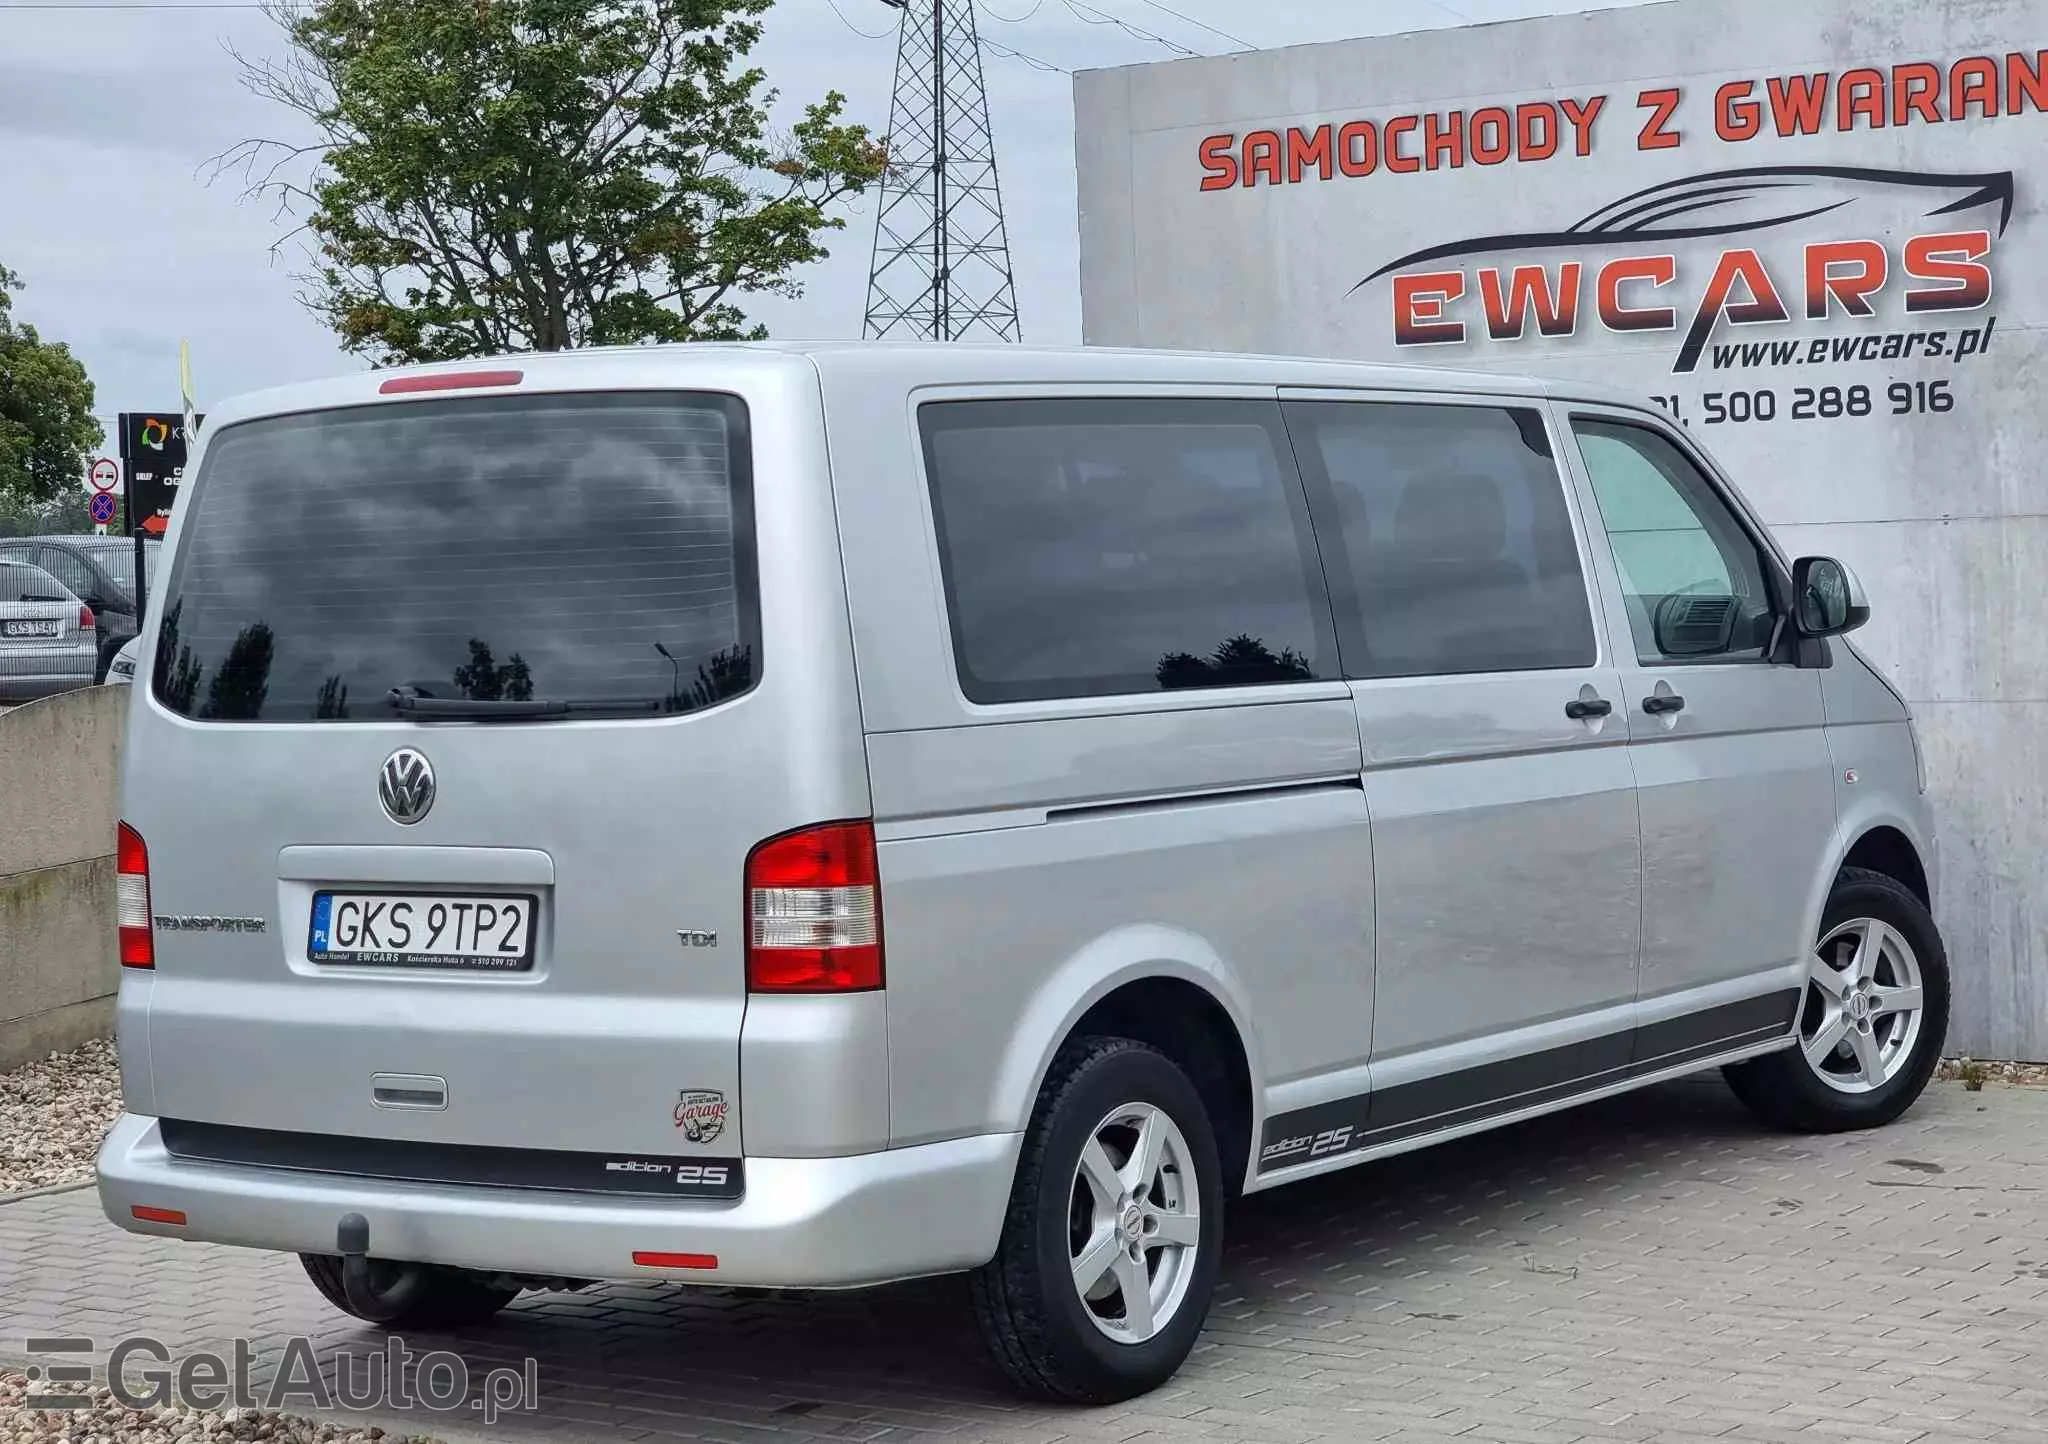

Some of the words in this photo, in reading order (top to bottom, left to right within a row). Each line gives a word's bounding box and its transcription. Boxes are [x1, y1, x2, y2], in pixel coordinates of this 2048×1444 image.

[1199, 95, 1607, 192] SAMOCHODY
[1637, 88, 1681, 151] Z
[1714, 49, 2048, 142] GWARAN
[1392, 230, 1995, 374] EWCARS
[1713, 315, 1996, 370] www.ewcars.pl
[1704, 389, 1776, 424] 500
[1792, 384, 1872, 420] 288
[1888, 380, 1954, 415] 916
[153, 914, 266, 933] TRANSPORTER
[314, 930, 328, 943] PL
[335, 901, 414, 949] GKS
[424, 902, 522, 953] 9TP2
[676, 929, 718, 948] TDI
[356, 952, 400, 962] EWCARS
[672, 1102, 729, 1127] Garage
[1262, 1134, 1313, 1156] edition
[1310, 1125, 1354, 1156] 25
[605, 1160, 672, 1175] edition
[676, 1165, 729, 1185] 25
